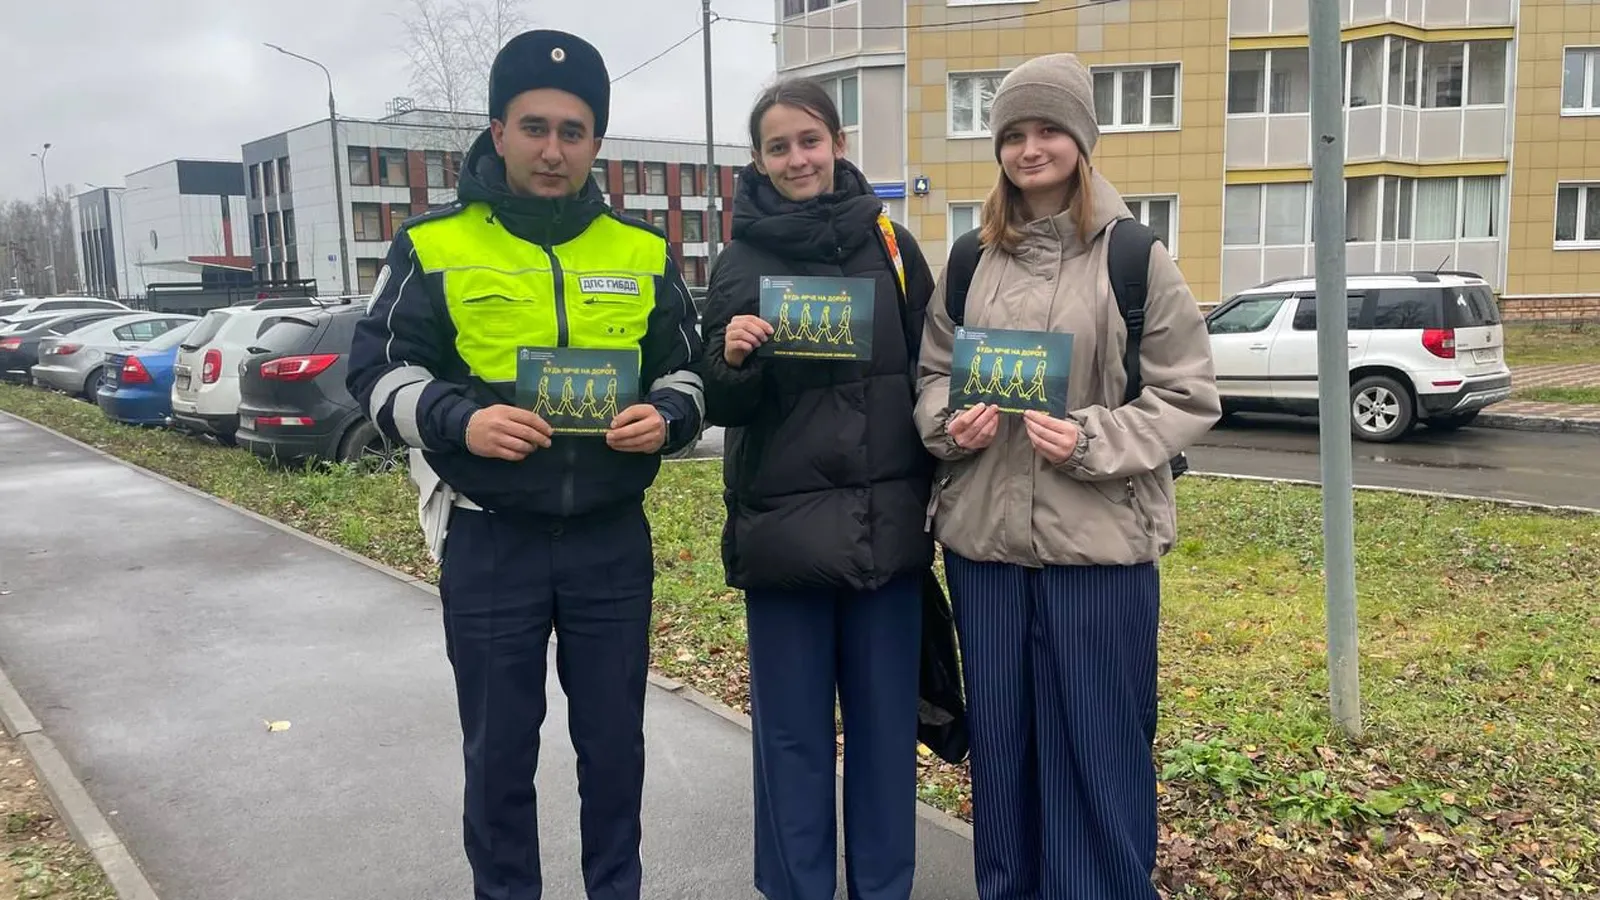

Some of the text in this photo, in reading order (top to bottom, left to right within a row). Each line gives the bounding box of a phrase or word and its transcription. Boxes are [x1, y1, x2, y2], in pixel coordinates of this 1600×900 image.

[917, 180, 926, 190] 4
[584, 279, 637, 291] ДПС ГИБДД
